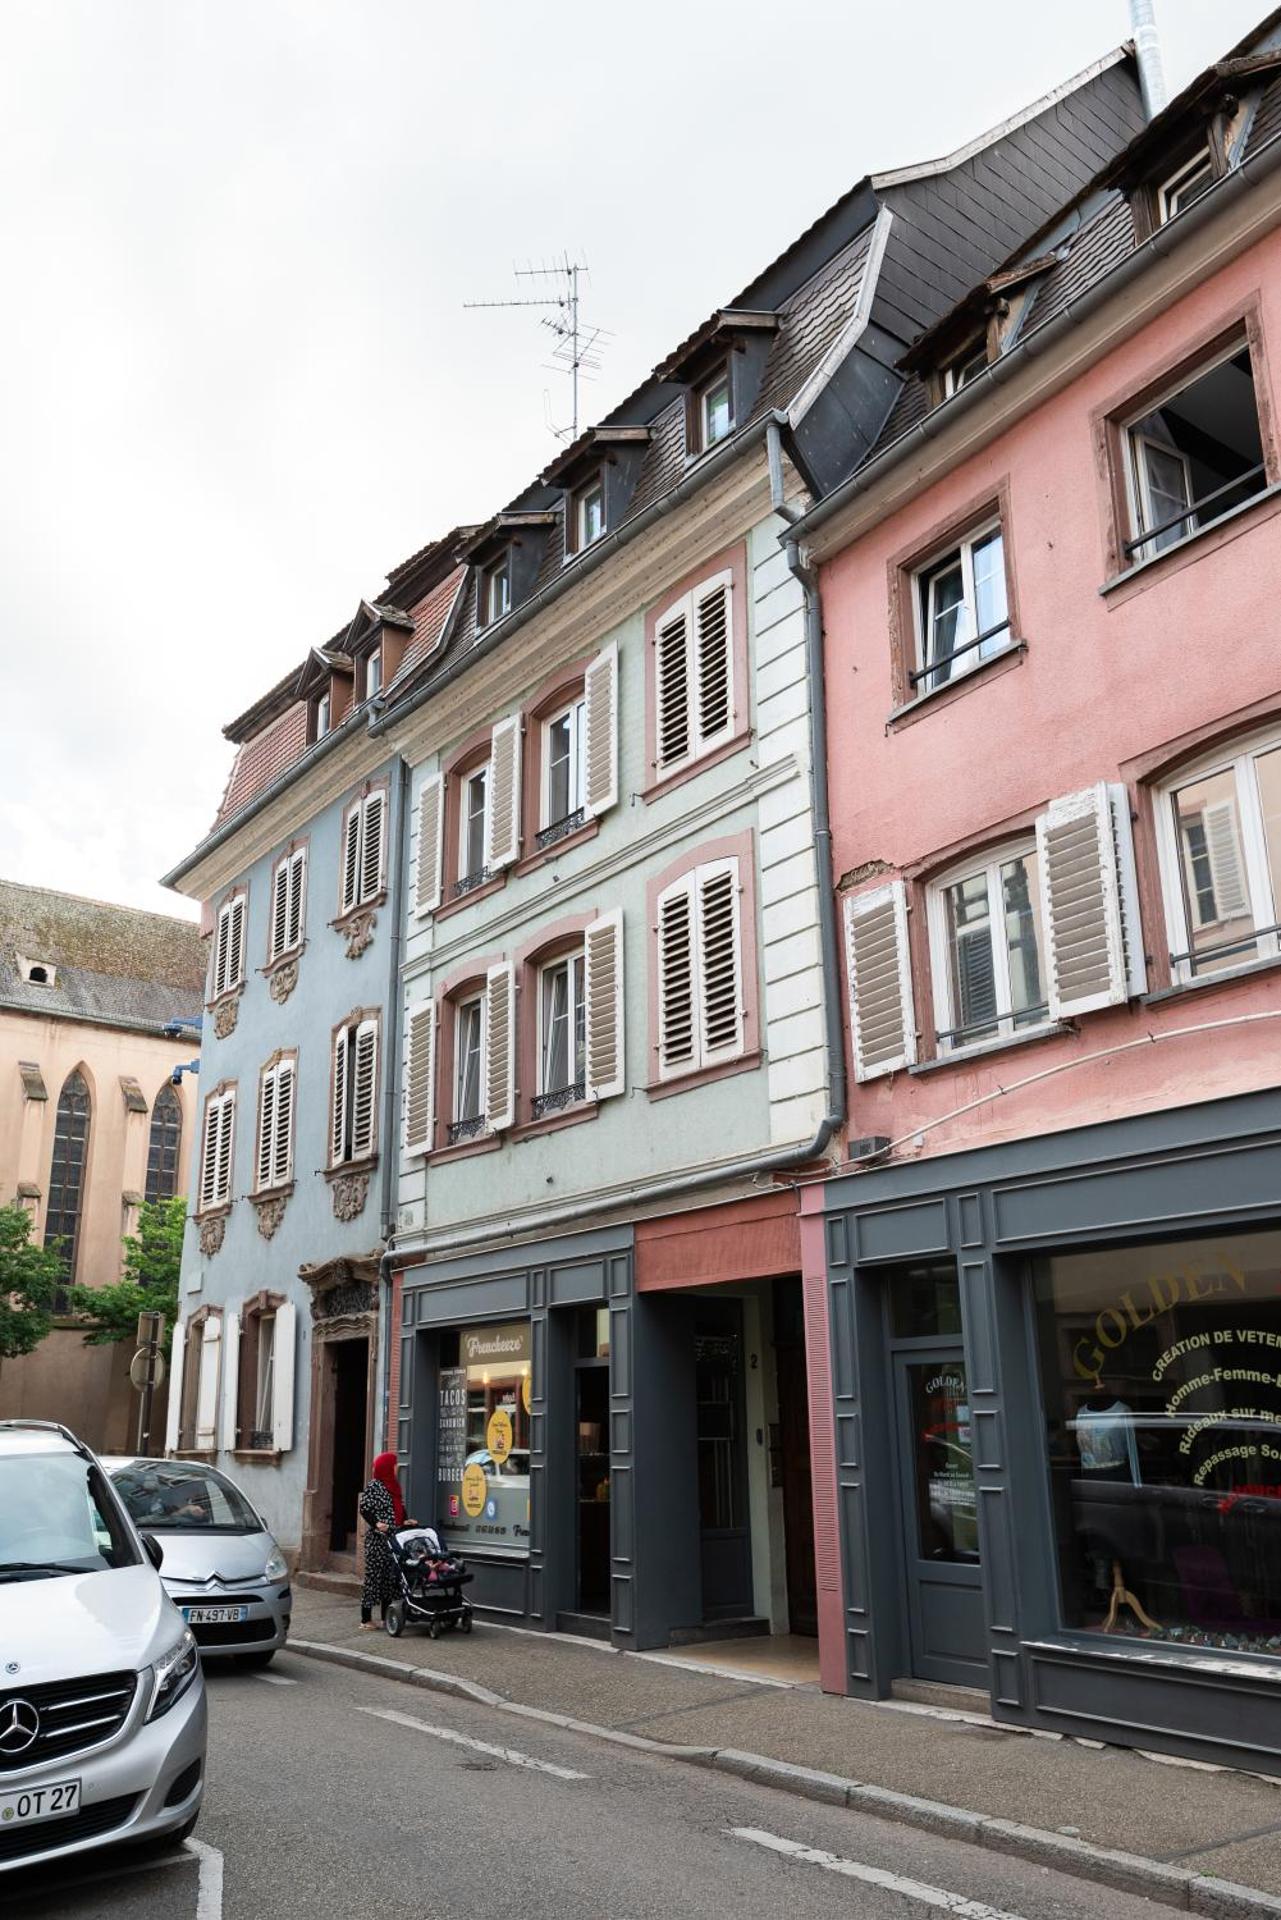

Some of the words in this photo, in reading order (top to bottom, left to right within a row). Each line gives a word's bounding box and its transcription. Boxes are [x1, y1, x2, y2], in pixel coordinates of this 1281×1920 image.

[1073, 1252, 1246, 1380] GOLDEN
[750, 1354, 758, 1369] 2
[1152, 1332, 1211, 1382] CREATION
[1213, 1330, 1234, 1344] DE
[440, 1389, 465, 1405] TACOS
[1179, 1409, 1228, 1454] Rideaux
[1231, 1407, 1257, 1419] sur
[1194, 1446, 1257, 1486] Repassage
[17, 1790, 46, 1817] OT
[50, 1784, 77, 1811] 27
